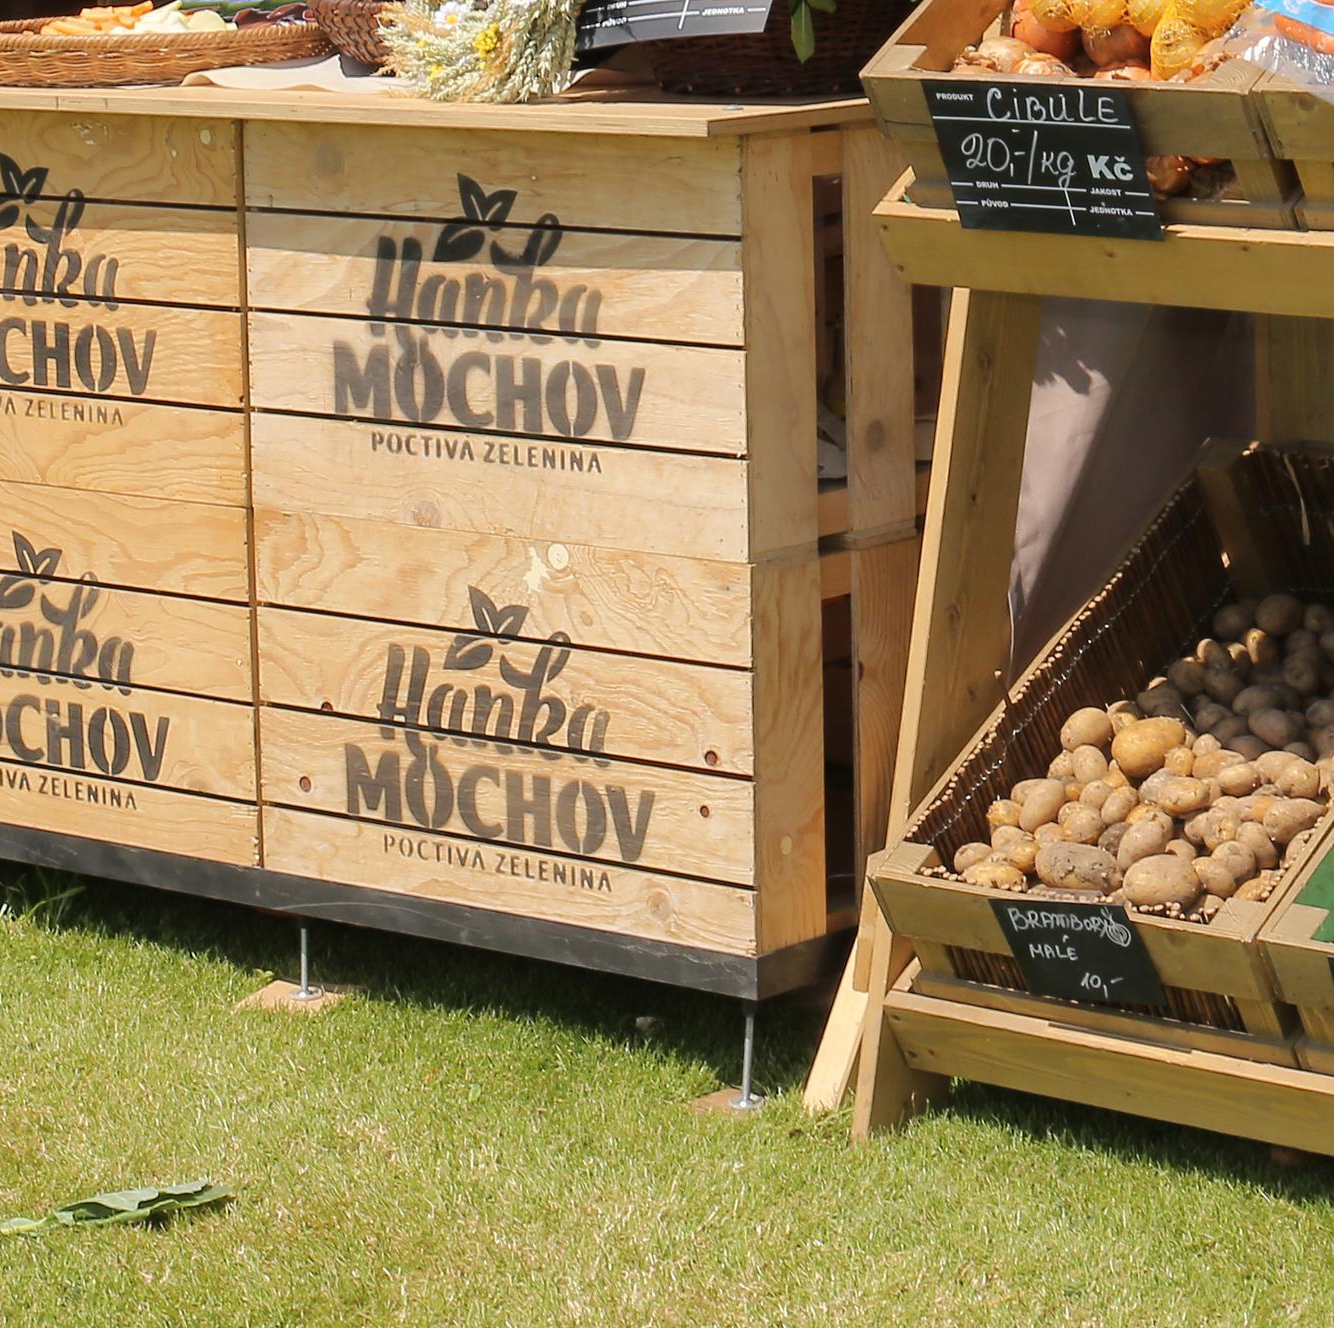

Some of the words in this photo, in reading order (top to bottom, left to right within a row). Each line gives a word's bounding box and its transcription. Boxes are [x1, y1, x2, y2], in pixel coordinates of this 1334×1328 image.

[701, 6, 745, 16] JEDNOTKA
[935, 92, 974, 102] PRODUKT
[1086, 154, 1134, 182] Kč
[976, 181, 999, 189] DRUH
[1090, 187, 1122, 197] JAKOST
[981, 198, 1009, 208] PŮVOD
[1089, 205, 1133, 216] JEDNOTKA
[365, 213, 603, 348] Hanka
[333, 338, 646, 442] MOCHOV
[24, 397, 124, 426] ZELENINA
[483, 440, 603, 474] ZELENINA
[376, 630, 612, 768] Hanka
[38, 775, 138, 811] ZELENINA
[344, 743, 656, 863] MOCHOV
[494, 852, 613, 893] ZELENINA
